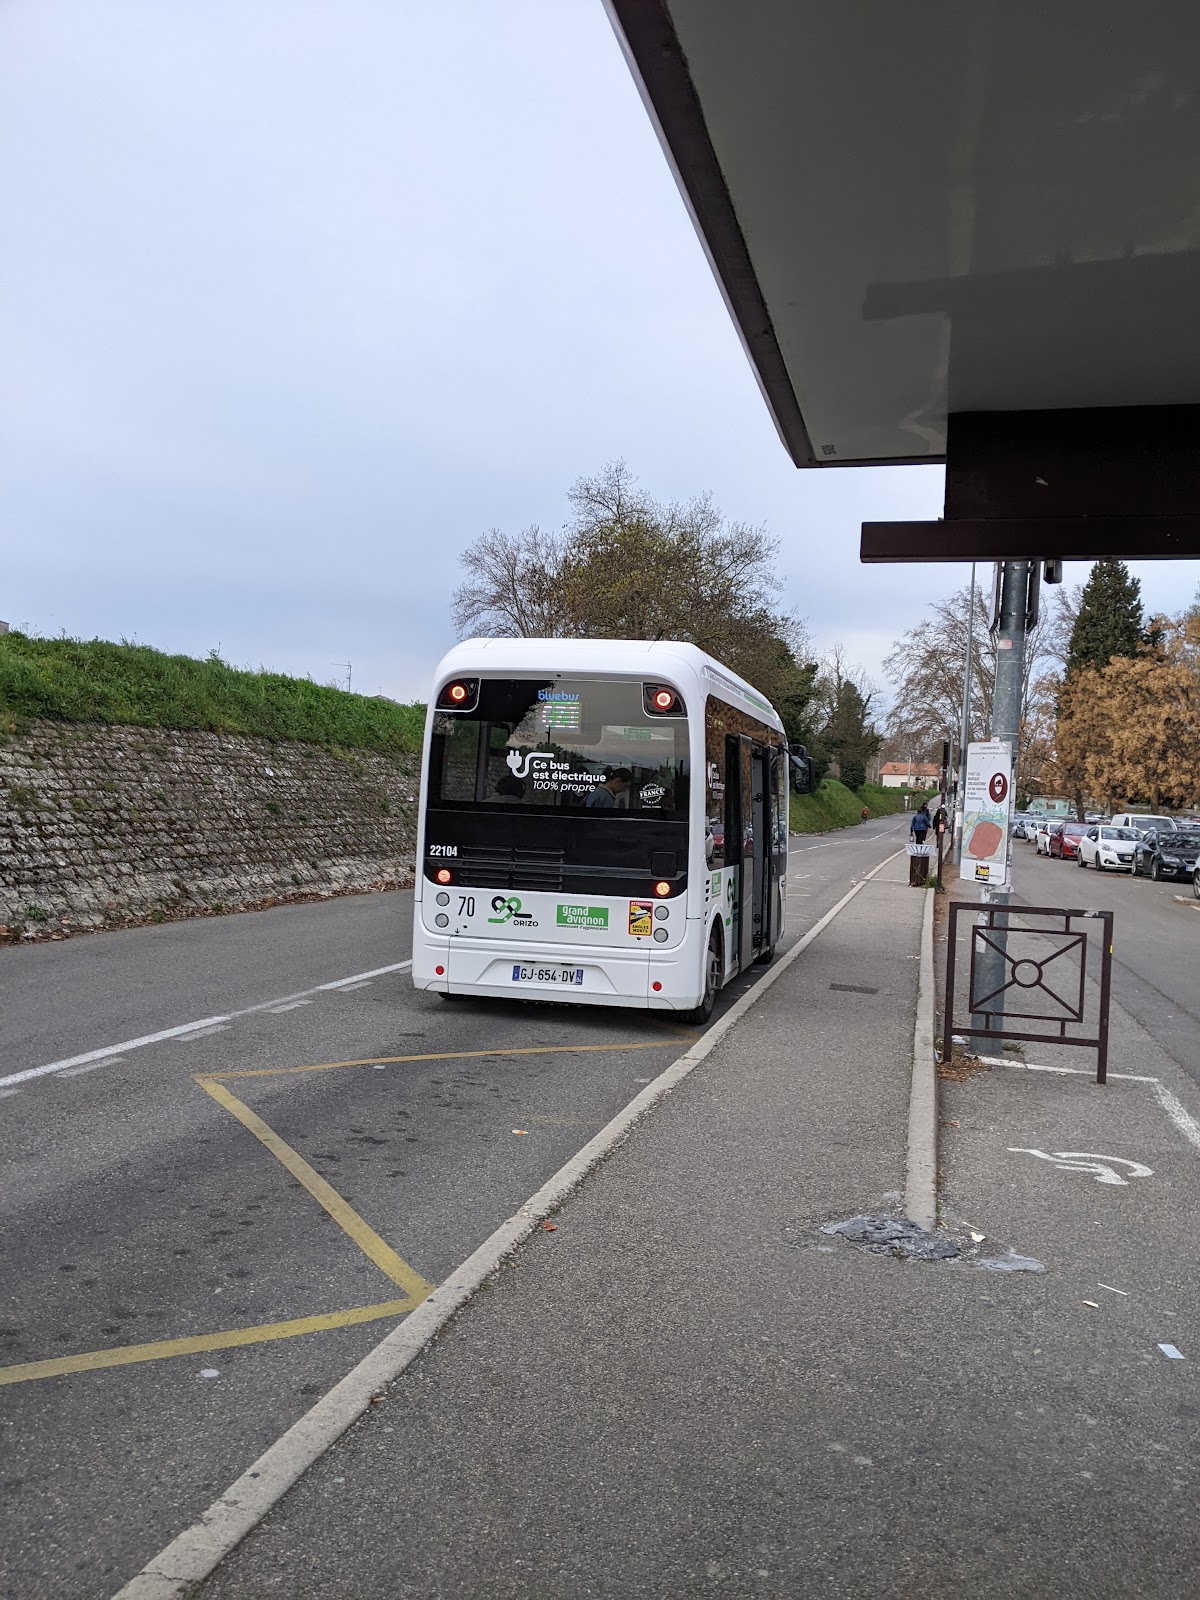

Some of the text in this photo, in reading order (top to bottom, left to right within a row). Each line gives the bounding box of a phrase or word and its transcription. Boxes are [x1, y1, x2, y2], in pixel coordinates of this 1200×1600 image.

[538, 690, 579, 701] bluebus
[533, 760, 570, 770] Ce bus
[532, 771, 607, 784] est électrique
[533, 780, 596, 793] 100% propre
[639, 788, 664, 798] FRANCE
[429, 845, 458, 857] 22104
[458, 896, 476, 917] 70
[562, 906, 589, 917] grand
[566, 914, 605, 926] avignon
[520, 968, 576, 983] GJ-654-DV
